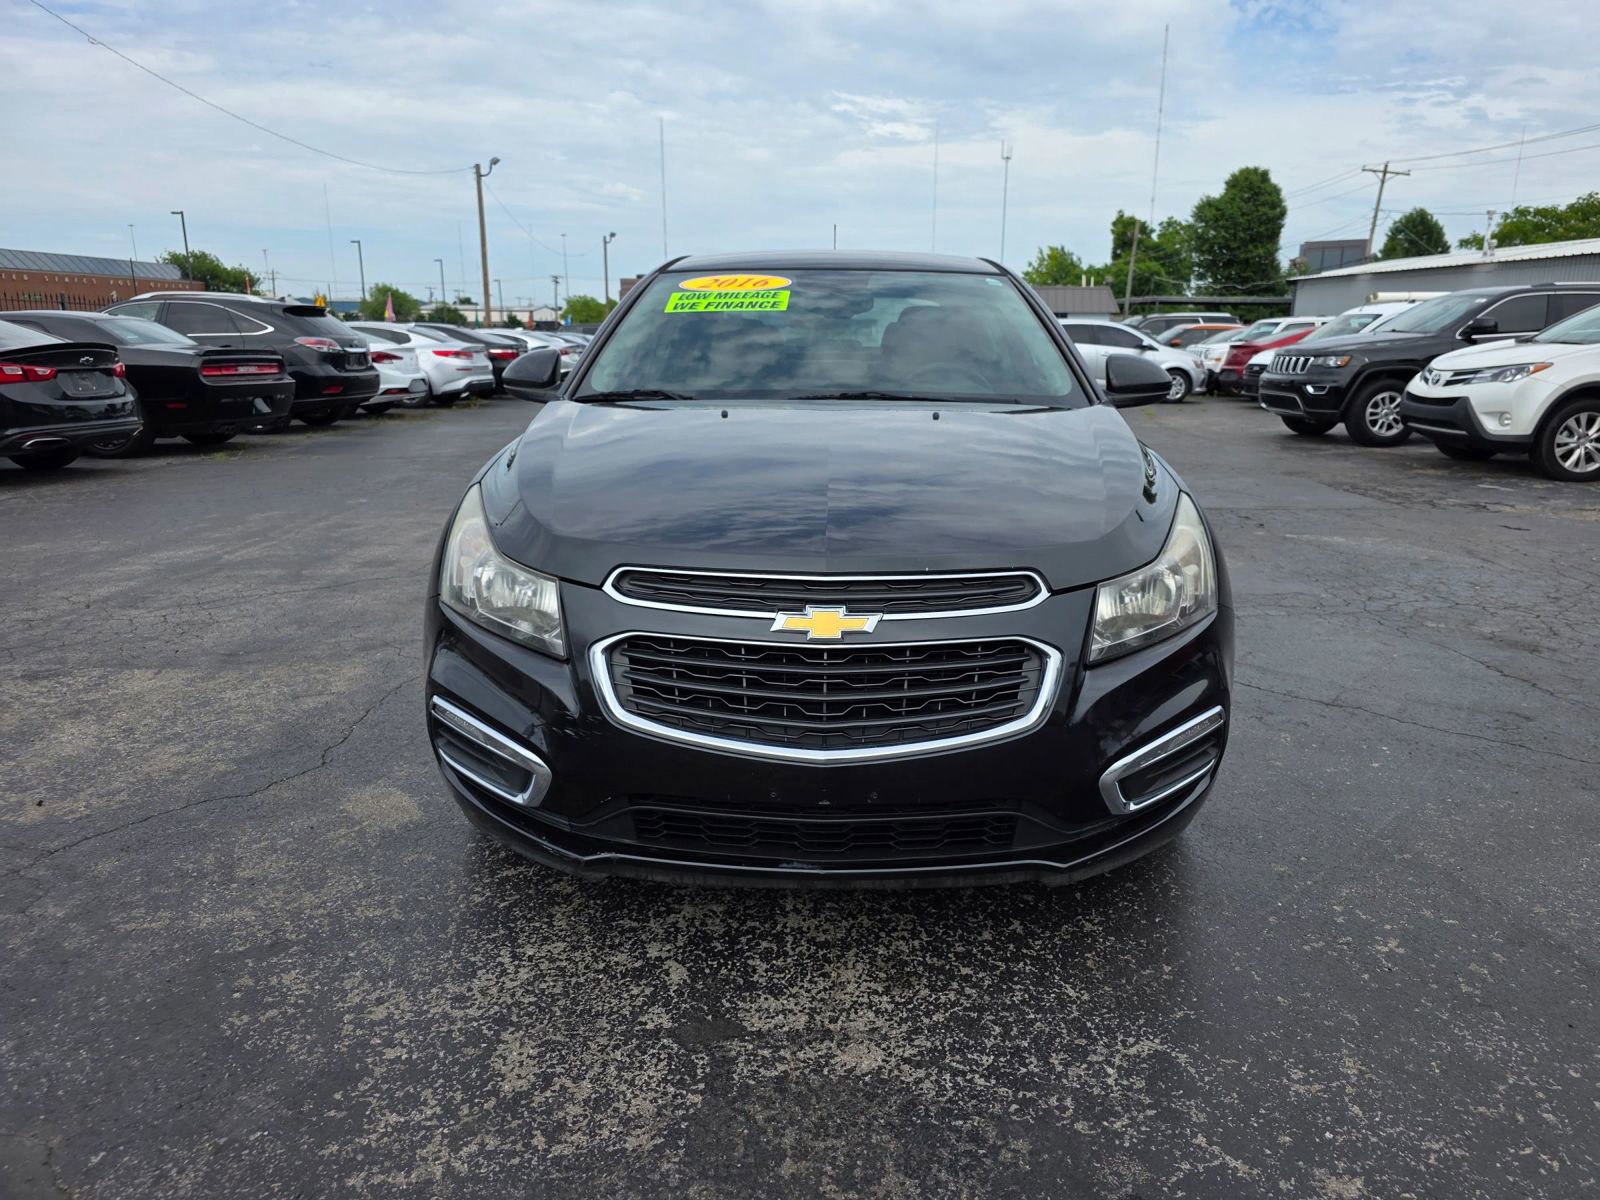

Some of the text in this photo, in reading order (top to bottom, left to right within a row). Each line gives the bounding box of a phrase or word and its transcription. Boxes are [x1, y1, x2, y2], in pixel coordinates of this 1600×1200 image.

[697, 277, 770, 289] 2016
[678, 290, 782, 301] LOW MILEAGE
[673, 300, 783, 311] WE FINANCE
